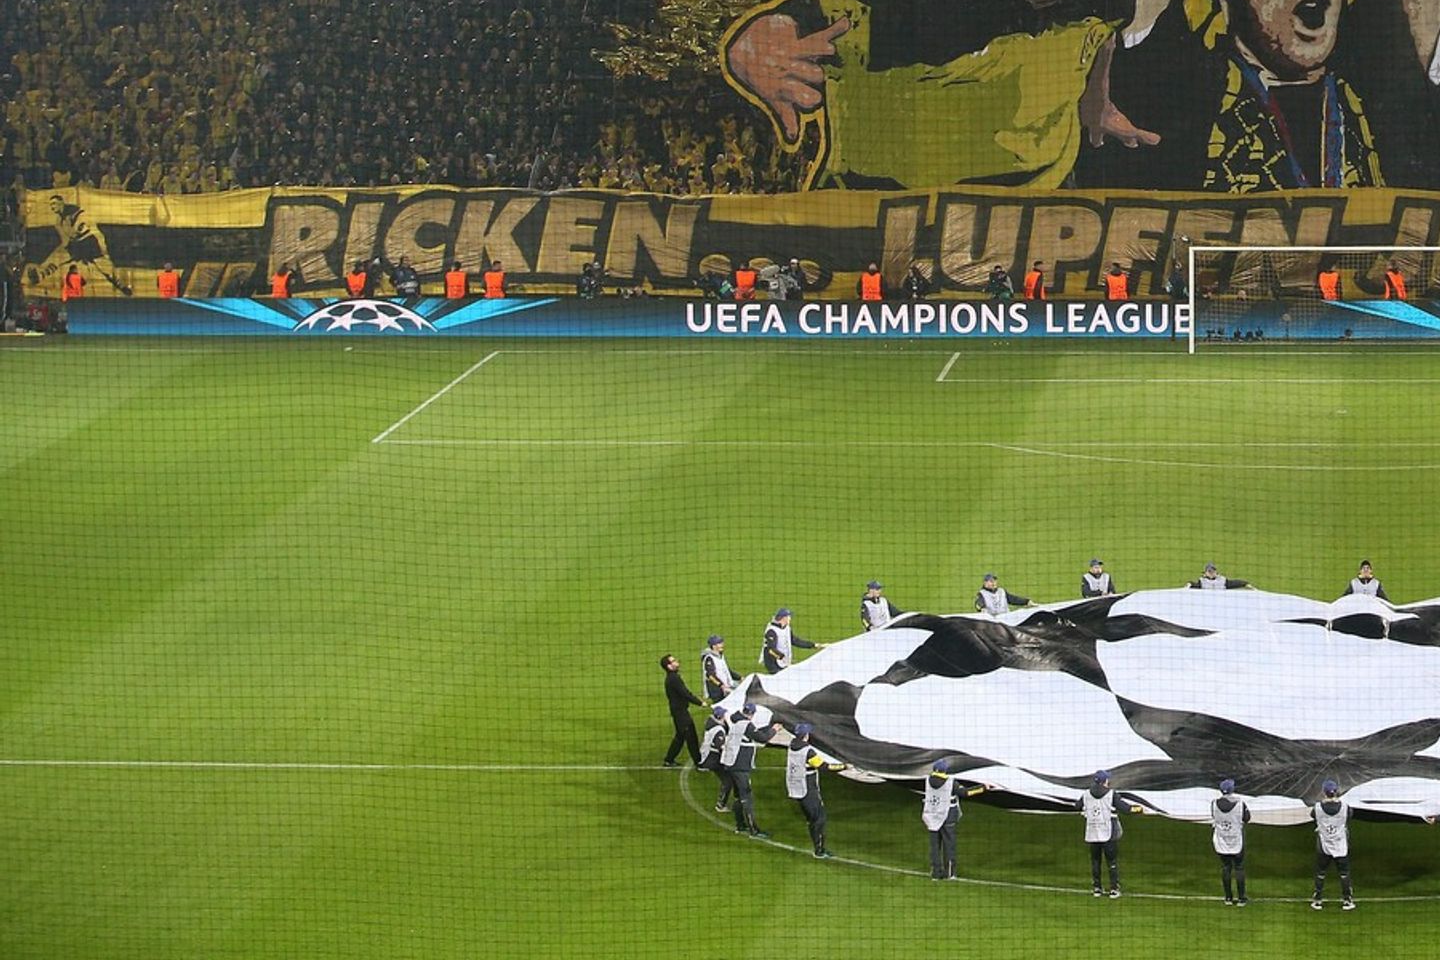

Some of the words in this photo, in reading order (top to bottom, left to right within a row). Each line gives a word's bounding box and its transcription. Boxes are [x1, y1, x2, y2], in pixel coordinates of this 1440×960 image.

[685, 303, 786, 333] UEFA
[798, 303, 1029, 334] CHAMPIONS
[1044, 303, 1191, 334] LEAGUE
